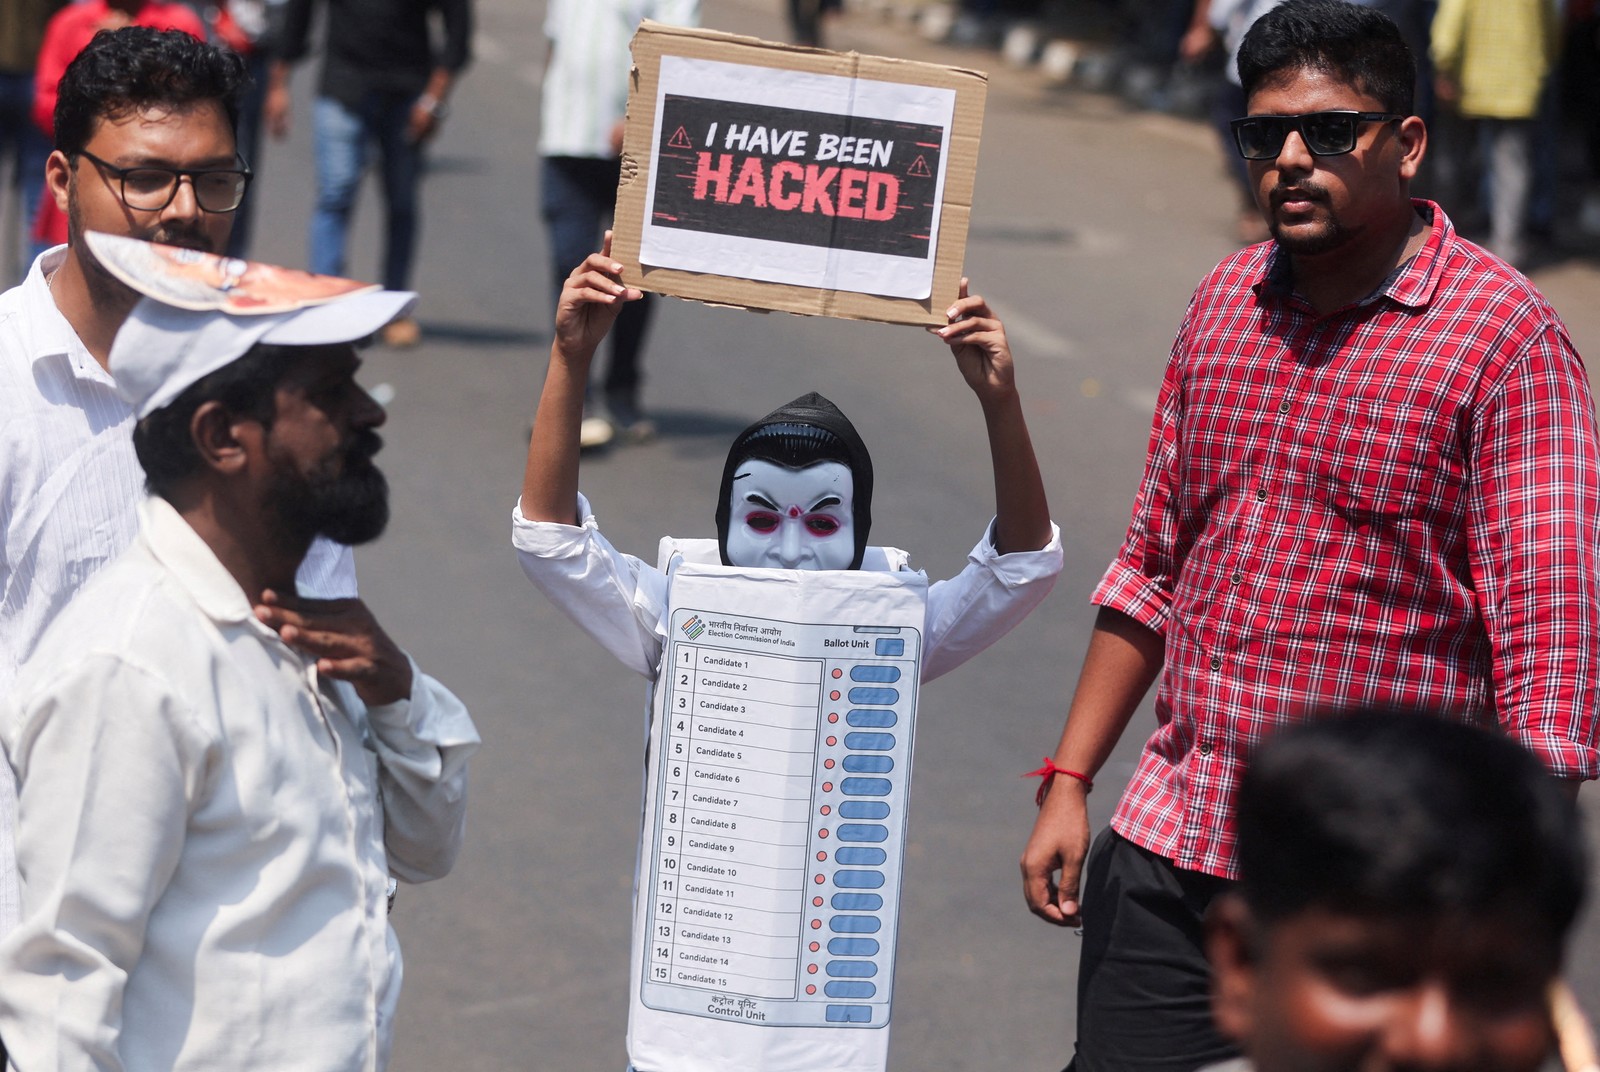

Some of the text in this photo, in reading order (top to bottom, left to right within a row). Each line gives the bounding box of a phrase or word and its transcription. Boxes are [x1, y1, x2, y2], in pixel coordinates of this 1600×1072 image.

[705, 122, 894, 168] I HAVE BEEN
[693, 151, 900, 222] HACKED
[708, 620, 782, 636] भारतीय निर्वाचन आयोग
[708, 629, 733, 639] Election
[734, 632, 772, 644] Commission
[780, 639, 796, 647] India
[824, 638, 869, 649] Ballot Unit
[683, 653, 690, 662] 1
[704, 656, 749, 669] Candidate 1
[680, 675, 689, 685] 2
[702, 678, 748, 692] Candidate 2
[678, 698, 687, 708] 3
[700, 701, 746, 714] Candidate 3
[676, 721, 685, 731] 4
[698, 725, 744, 738] Candidate 4
[675, 743, 683, 754] 5
[696, 747, 742, 760] Candidate 5
[672, 767, 681, 777] 6
[695, 770, 741, 784] Candidate 6
[671, 790, 680, 800] 7
[693, 794, 739, 807] Candidate 7
[668, 813, 678, 823] 8
[691, 817, 737, 830] Candidate 8
[667, 836, 676, 846] 9
[689, 840, 735, 853] Candidate 9
[663, 858, 677, 869] 10
[687, 863, 737, 877] Candidate 10
[662, 880, 673, 891] 11
[685, 884, 734, 898] Candidate 11
[659, 903, 673, 914] 12
[683, 907, 734, 921] Candidate 12
[658, 926, 671, 936] 13
[681, 930, 732, 944] Candidate 13
[656, 948, 669, 958] 14
[680, 952, 729, 966] Candidate 14
[655, 968, 668, 978] 15
[678, 972, 727, 987] Candidate 15
[737, 998, 757, 1009] यूनिट
[707, 1004, 766, 1021] Control Unit
